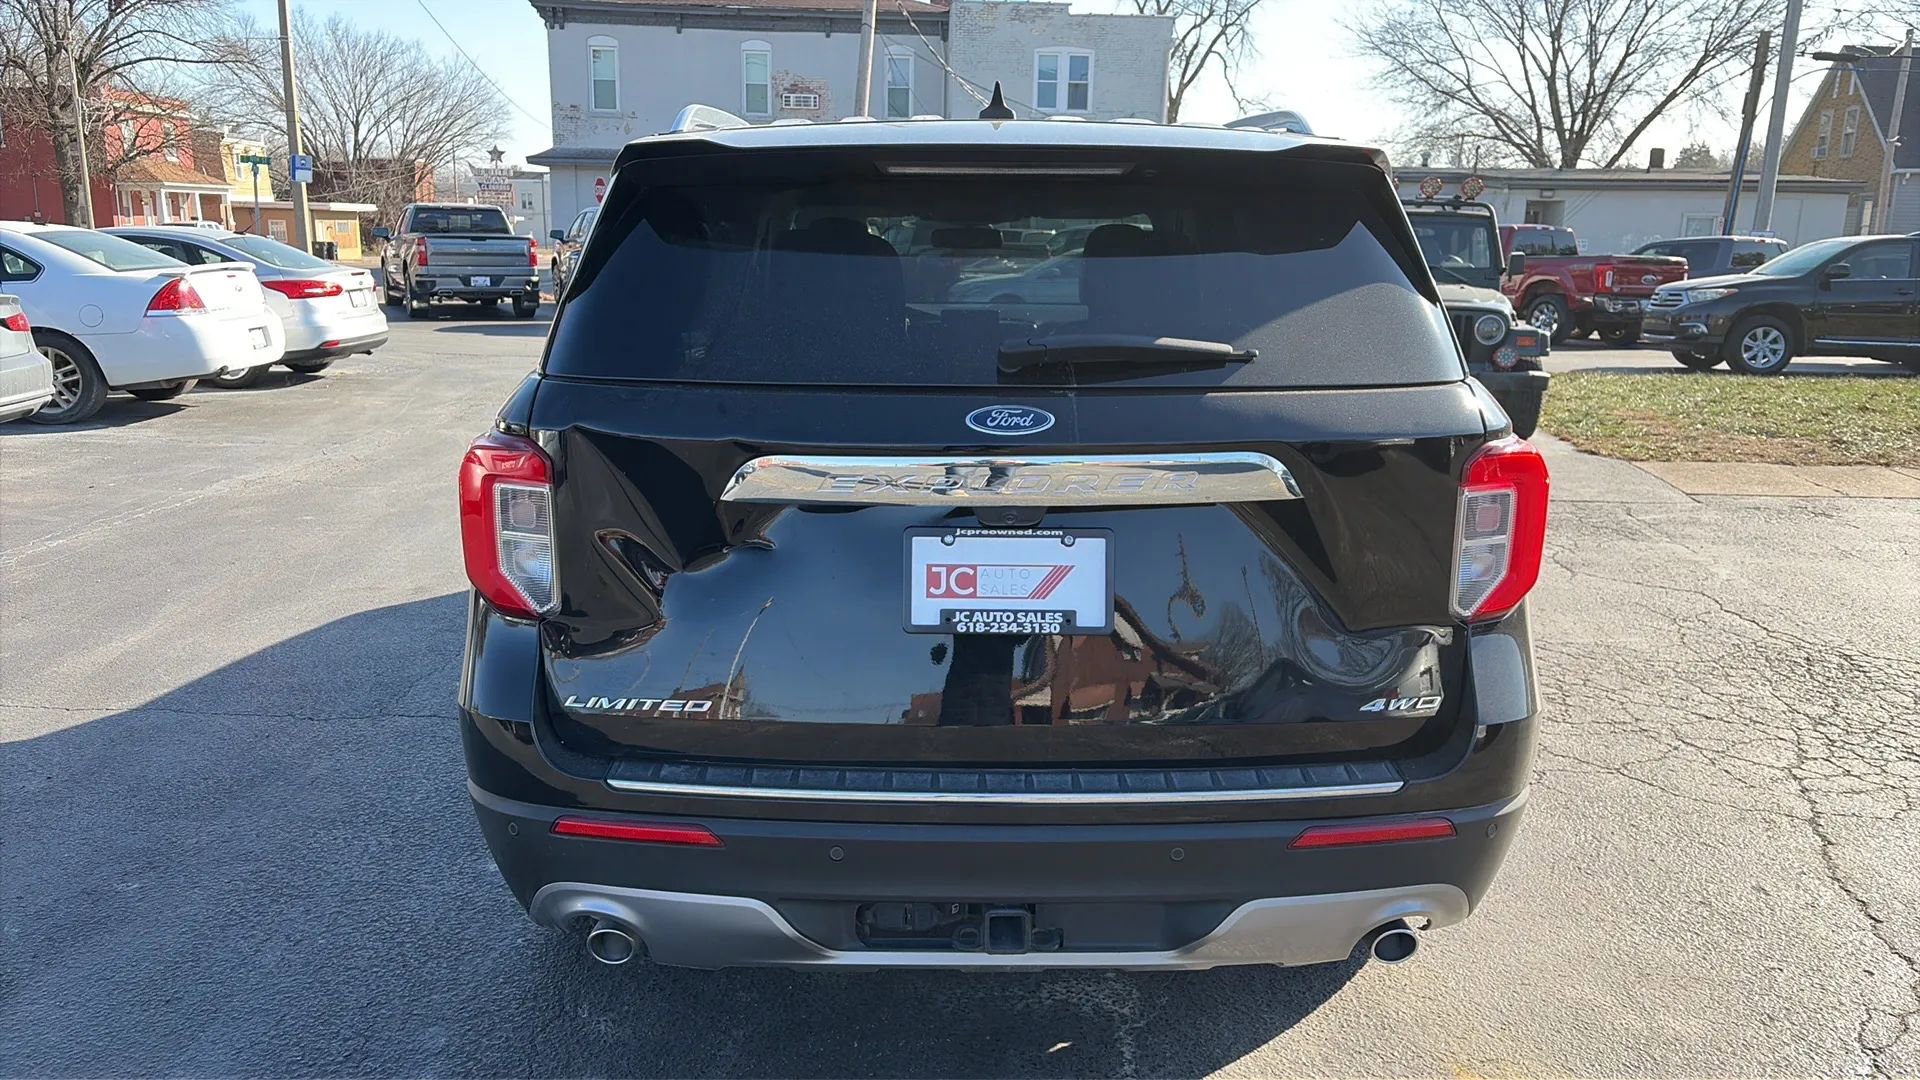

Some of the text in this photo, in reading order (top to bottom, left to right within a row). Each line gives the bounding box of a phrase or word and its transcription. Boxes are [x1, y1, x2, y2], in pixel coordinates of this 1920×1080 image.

[986, 409, 1035, 427] Ford
[815, 470, 1201, 494] EXPLORER
[955, 528, 1063, 536] jcpreowned.com
[981, 568, 1031, 580] AUTO
[929, 567, 975, 595] JC
[981, 584, 1029, 595] SALES
[952, 612, 1063, 623] JC AUTO SALES
[956, 623, 1061, 634] 618-234-3130
[564, 695, 713, 712] LIMITED
[1360, 696, 1441, 711] 4WD
